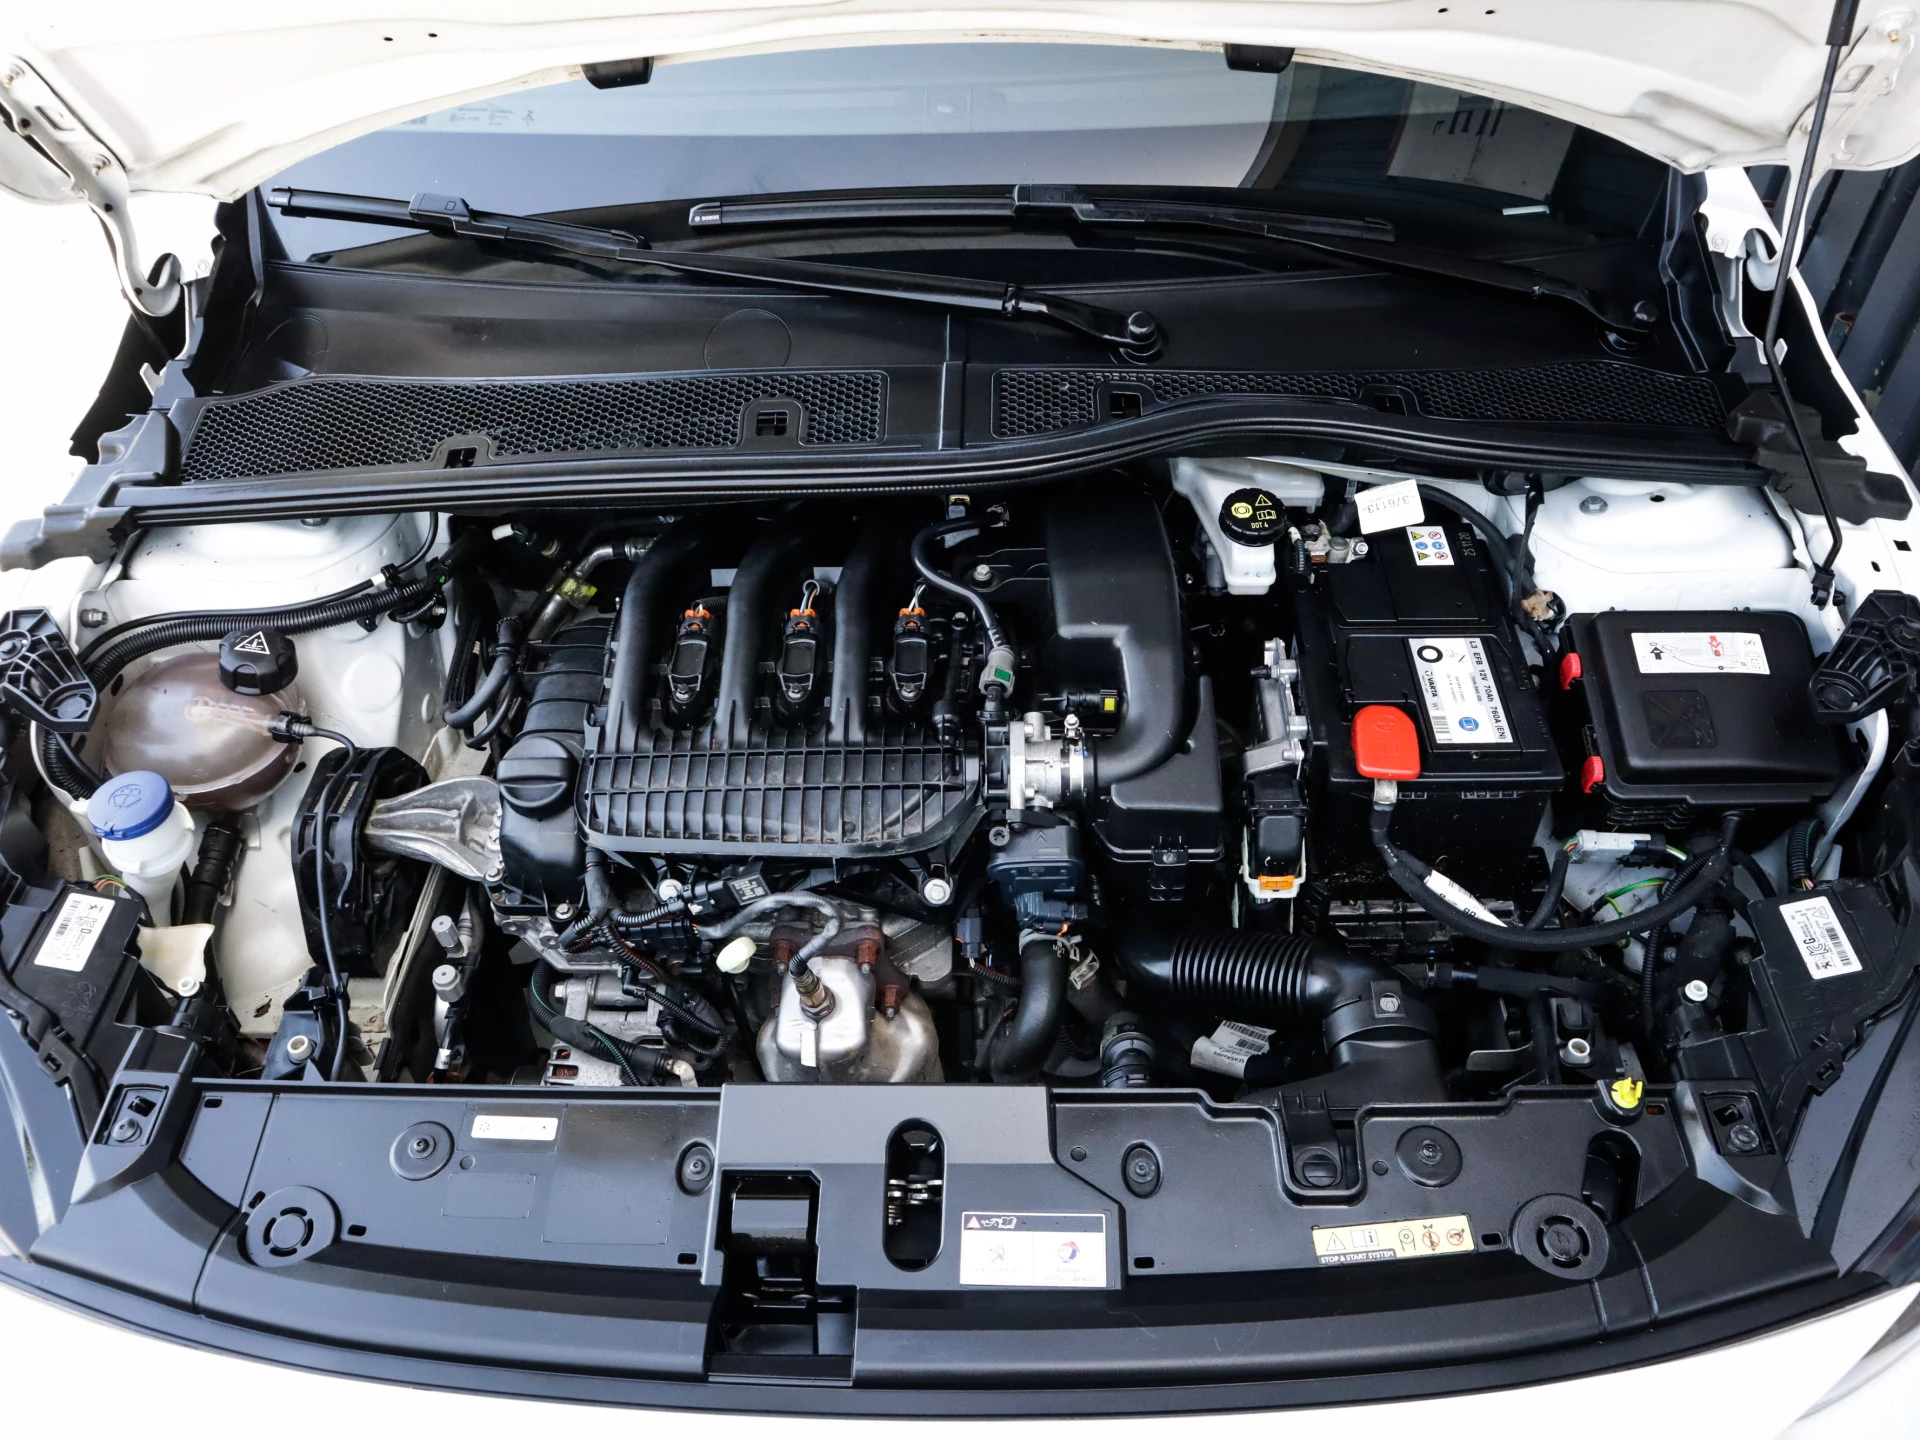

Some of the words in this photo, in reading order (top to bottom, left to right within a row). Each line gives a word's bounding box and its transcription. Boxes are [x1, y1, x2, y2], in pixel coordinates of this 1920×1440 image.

[1469, 640, 1478, 649] L3
[1473, 652, 1483, 665] EFB
[1479, 669, 1488, 681] 12V
[1427, 677, 1438, 697] VARTA
[1484, 685, 1494, 702] 70Ah
[1490, 706, 1502, 724] 760A
[1495, 725, 1507, 740] (EN)
[1320, 1255, 1339, 1264] STOP
[1346, 1252, 1367, 1262] START
[1368, 1251, 1394, 1259] SYSTEM
